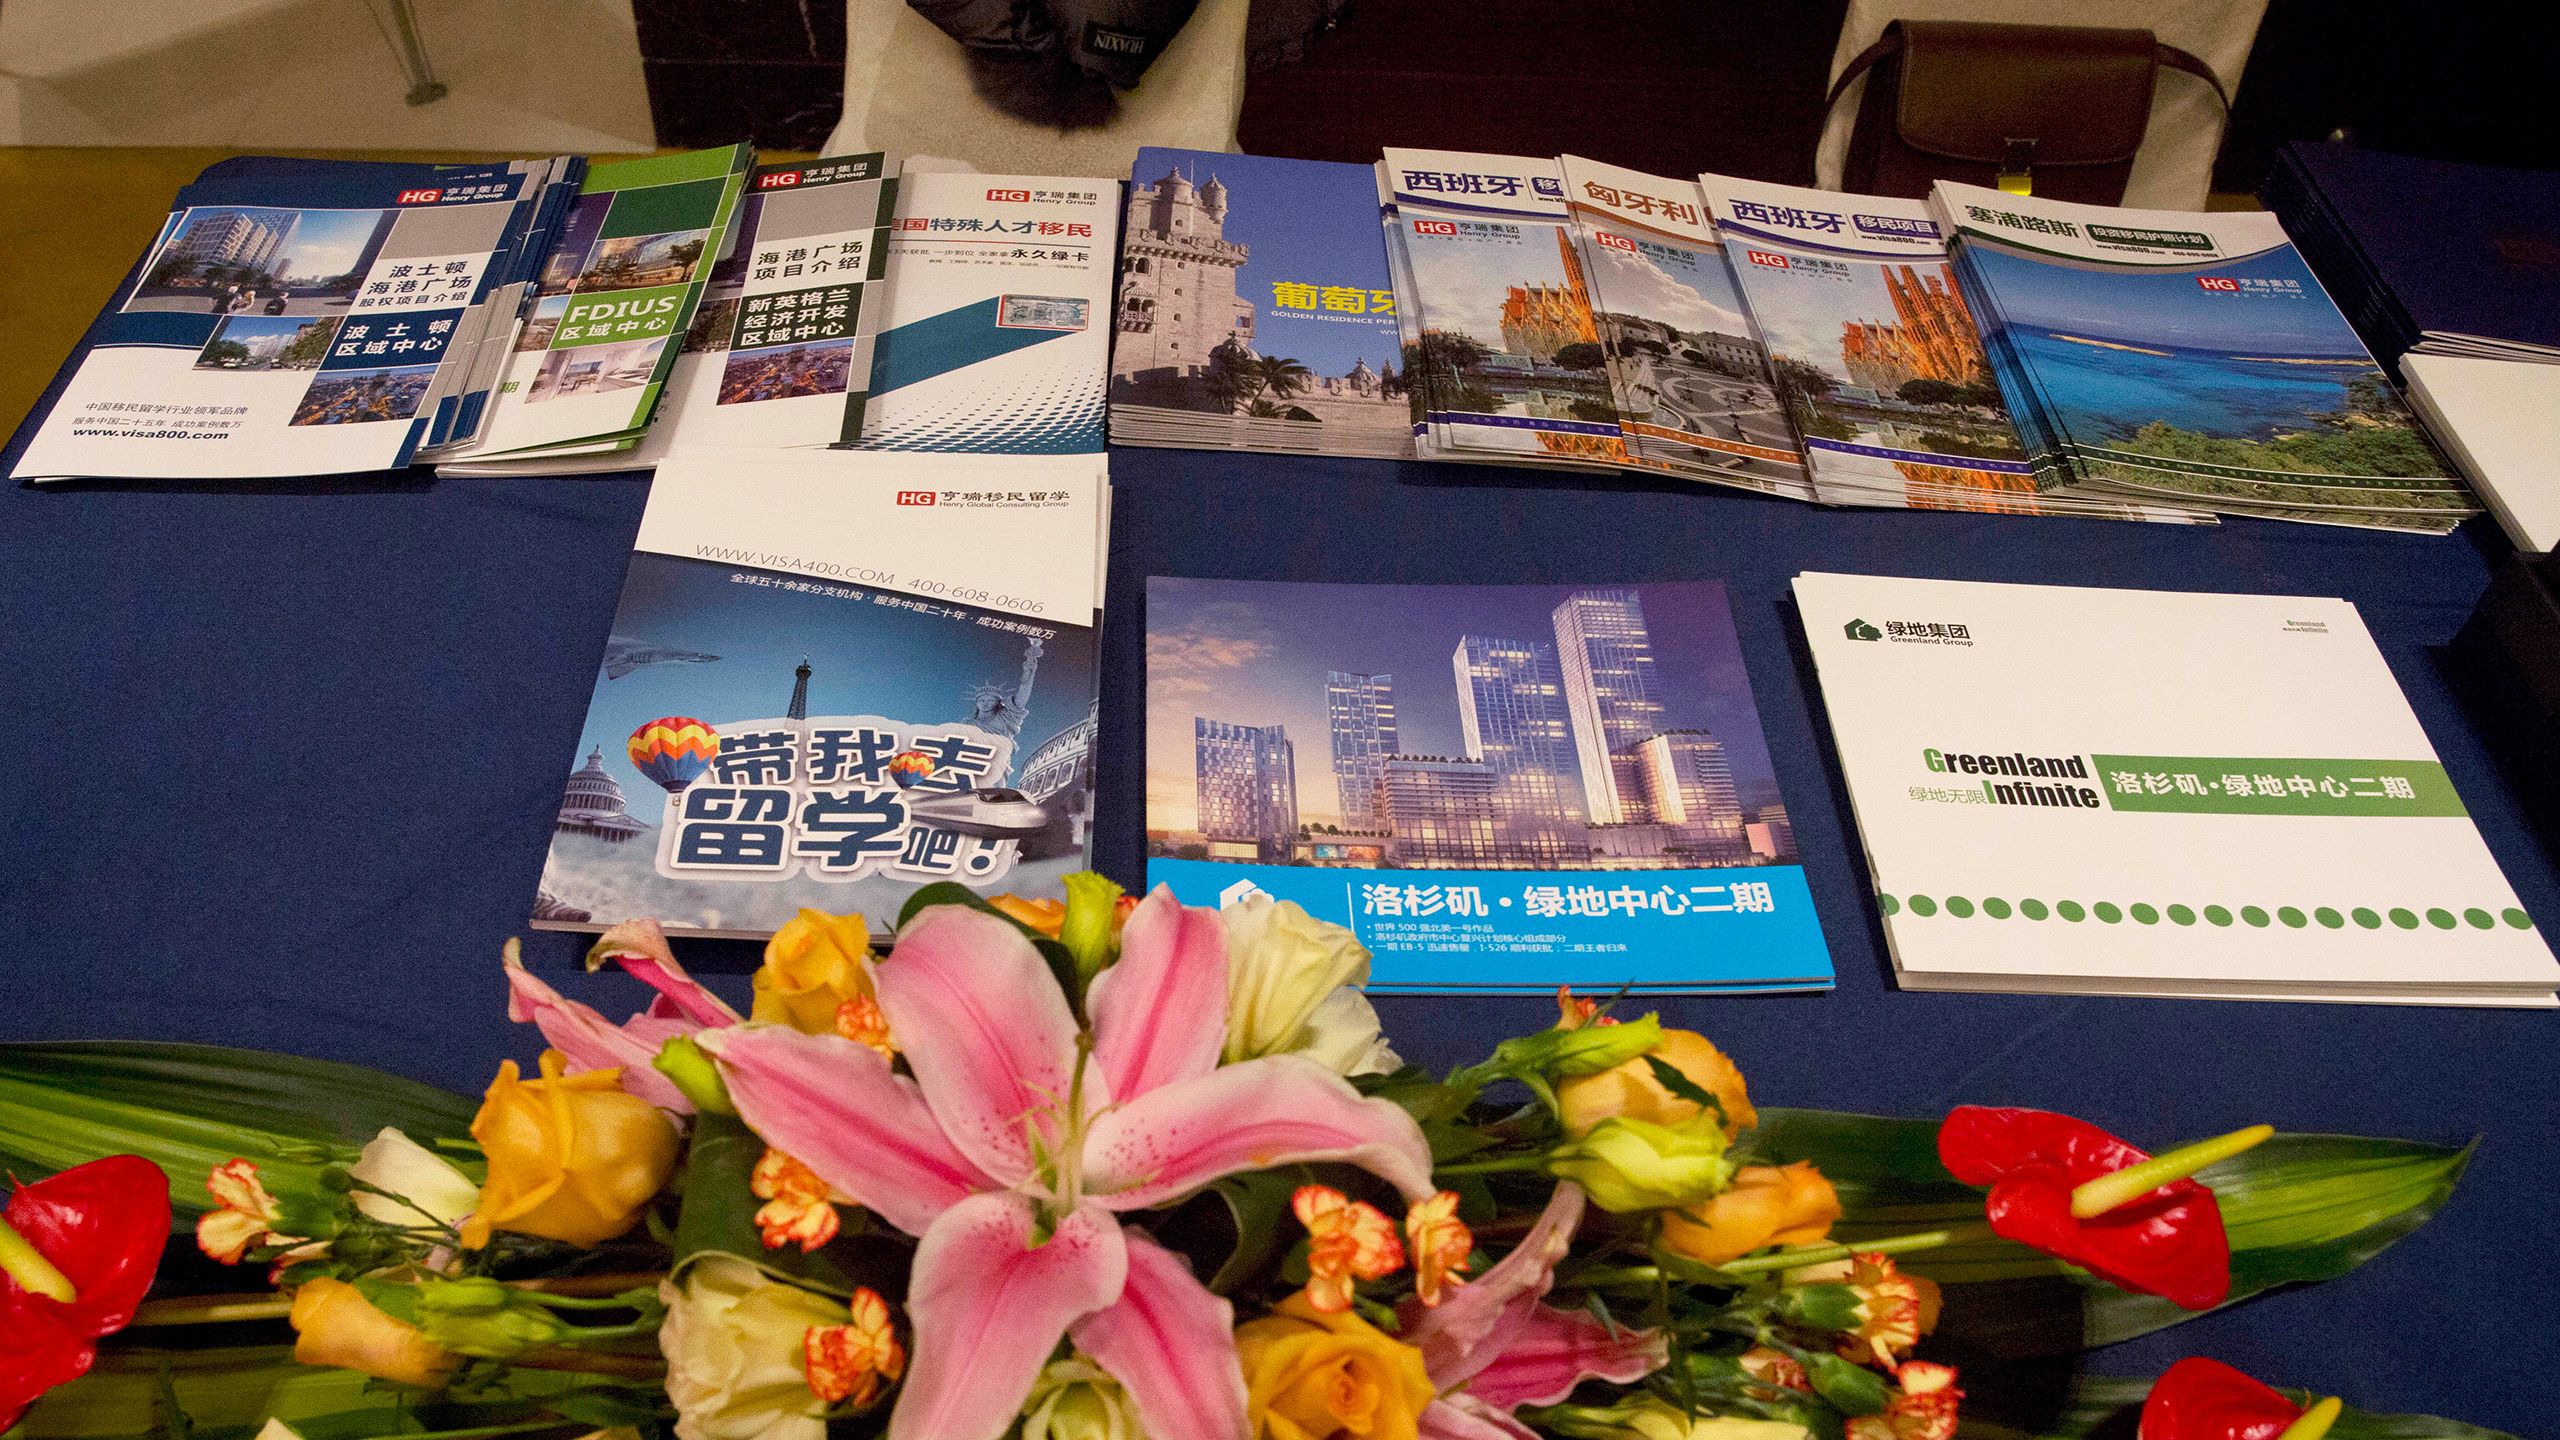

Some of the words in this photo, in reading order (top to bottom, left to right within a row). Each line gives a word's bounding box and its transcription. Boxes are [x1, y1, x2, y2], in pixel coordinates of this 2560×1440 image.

[762, 174, 797, 187] HG
[803, 175, 831, 183] Henry
[835, 171, 865, 180] Group
[1402, 170, 1524, 196] 西班牙
[402, 191, 438, 202] HG
[474, 192, 503, 200] Group
[991, 191, 1025, 201] HG
[1584, 181, 1699, 225] 匈牙利
[1728, 198, 1846, 234] 西班牙
[1965, 205, 2080, 238] 塞浦路斯
[1419, 222, 1453, 234] HG
[1460, 230, 1487, 238] Henry
[1491, 232, 1521, 240] Group
[1600, 233, 1632, 250] HG
[758, 241, 863, 265] 海港广场
[1752, 253, 1785, 266] HG
[388, 261, 468, 278] 波士顿
[754, 256, 861, 280] 项目介绍
[1792, 264, 1820, 274] Henry
[1821, 268, 1850, 277] Group
[367, 276, 473, 295] 海港广场
[2200, 278, 2236, 290] HG
[358, 291, 468, 307] 股权项目介绍
[747, 288, 851, 313] 新英格兰
[1272, 281, 1398, 316] 葡萄牙
[569, 296, 676, 323] FDIUS
[743, 304, 848, 329] 经济开发
[1271, 310, 1314, 319] GOLDEN
[1317, 314, 1373, 324] RESIDENCE
[343, 319, 454, 340] 波士顿
[560, 317, 666, 340] 区域中心
[740, 321, 845, 346] 区域中心
[334, 337, 443, 357] 区域中心
[85, 402, 248, 415] 中国移民留学行业领军品牌
[73, 429, 229, 440] www.visa800.com
[901, 492, 931, 504] HG
[940, 490, 1070, 502] 亨瑞移民留学
[996, 501, 1040, 509] Consulting
[696, 544, 895, 585] WWW.VISA400.COM
[908, 578, 1045, 614] 400-608-0606
[1885, 621, 1970, 639] 绿地集团
[1890, 635, 1940, 645] Greenland
[1943, 638, 1974, 647] Group
[1922, 748, 2089, 779] Greenland
[1908, 786, 1987, 805] 绿地无限
[1982, 780, 2101, 809] Infinite
[1398, 923, 1416, 931] 500
